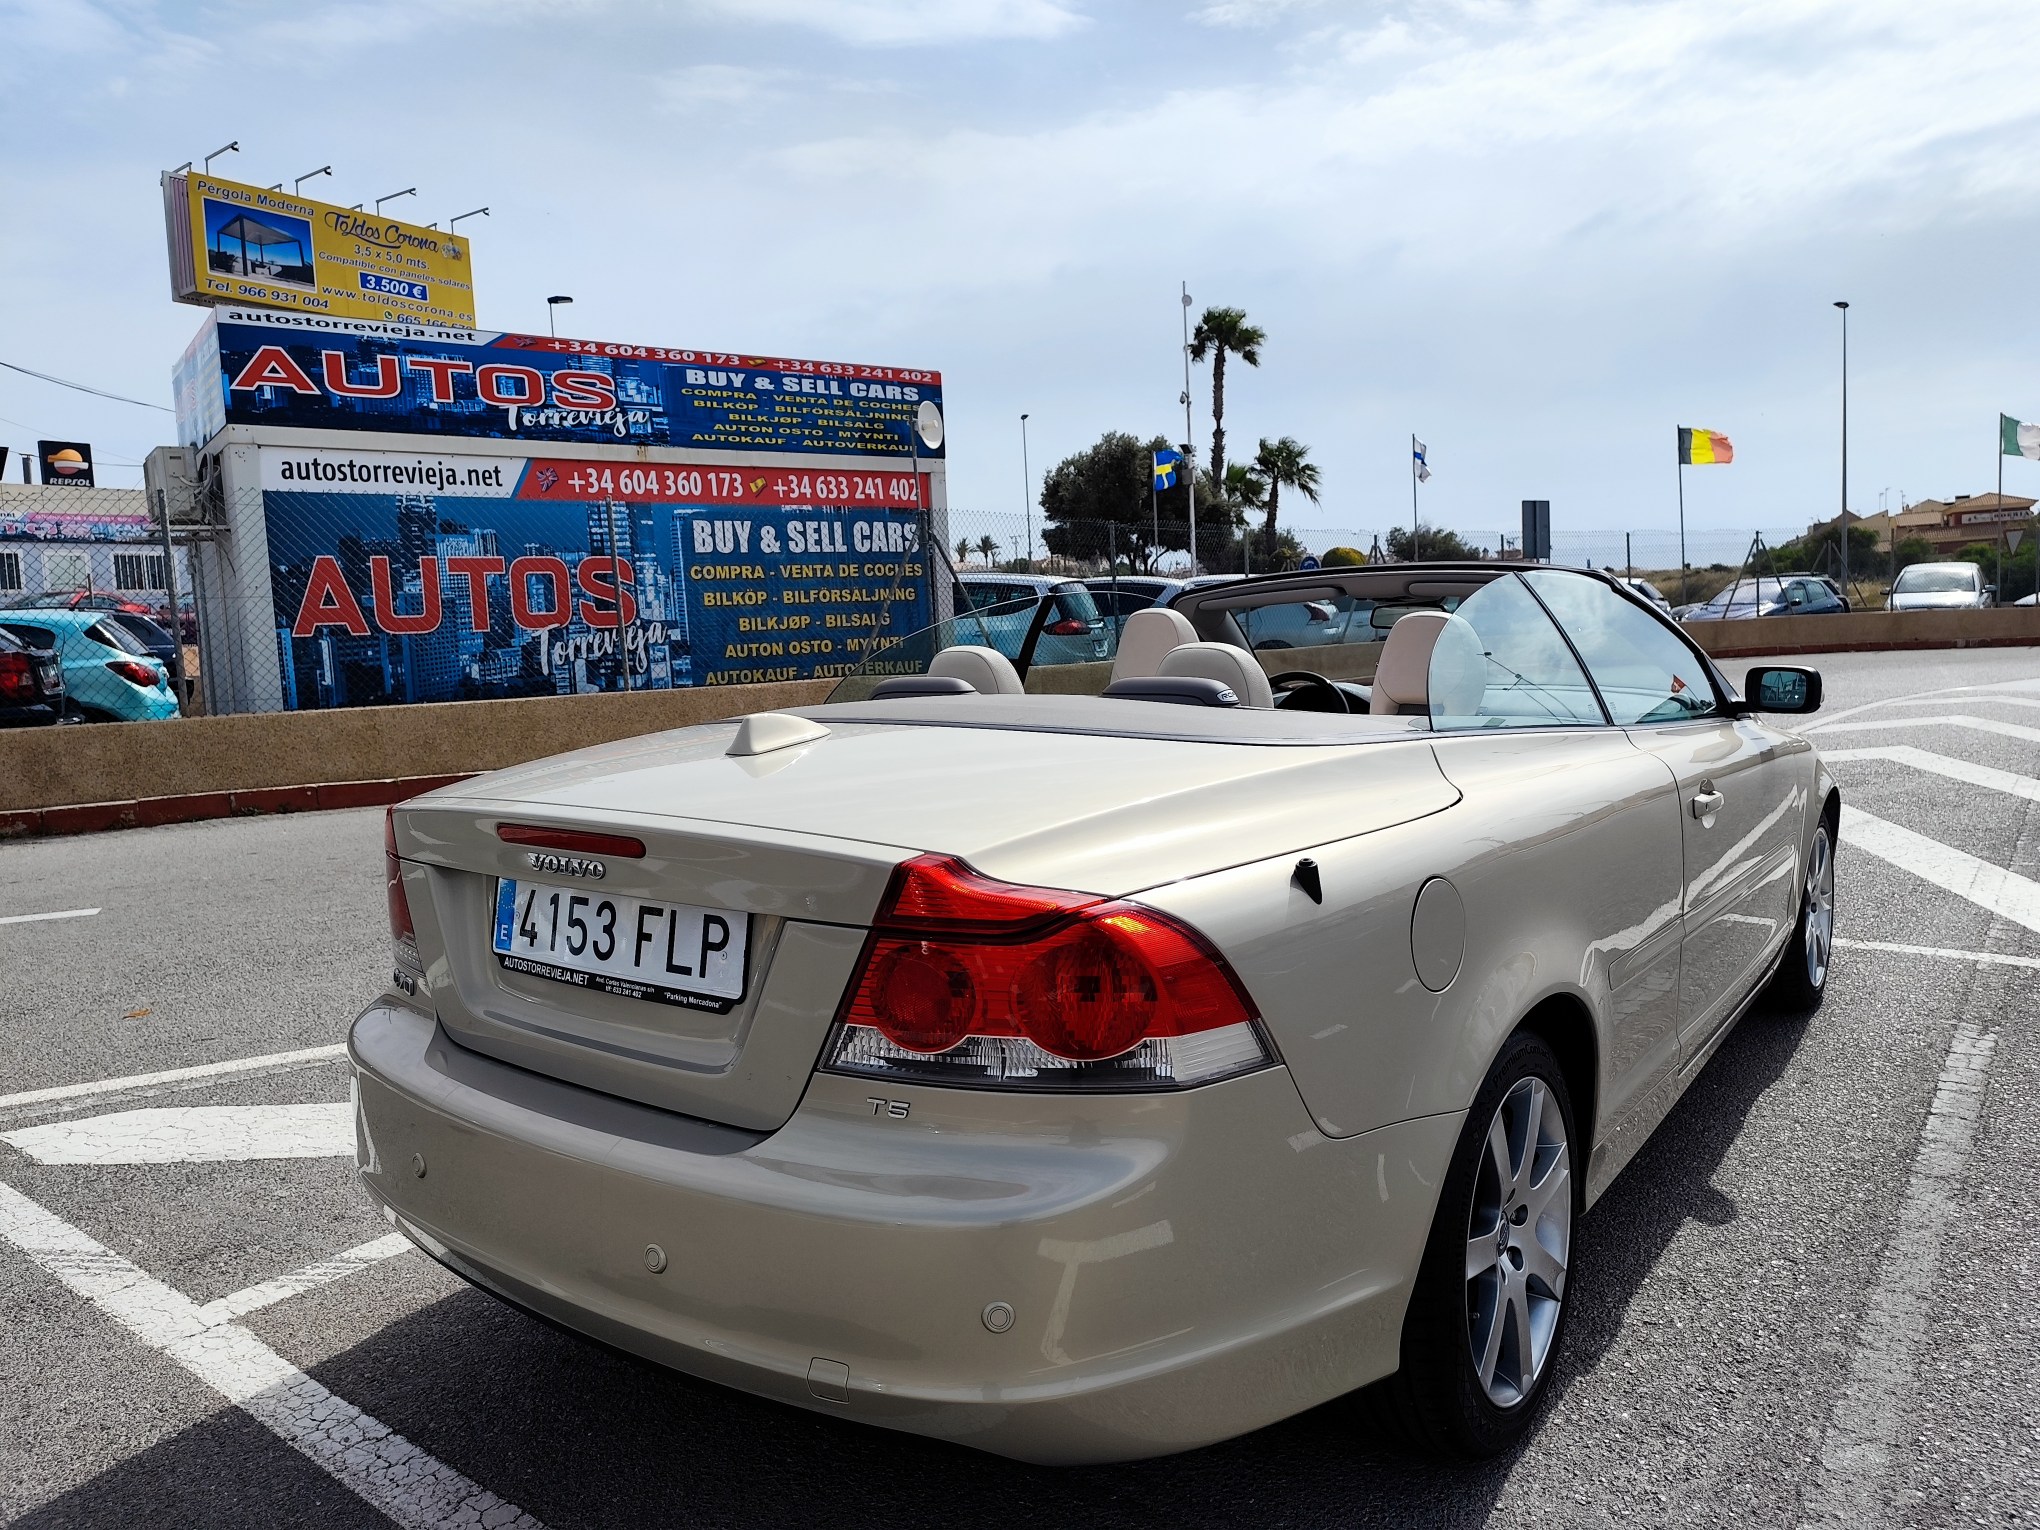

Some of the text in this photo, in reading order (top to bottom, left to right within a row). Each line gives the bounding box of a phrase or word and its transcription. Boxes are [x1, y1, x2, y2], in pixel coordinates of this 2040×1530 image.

[197, 180, 314, 216] Pérgola Moderna
[324, 212, 439, 253] Toldos Corona
[354, 244, 430, 270] 3,5 x 5,0 mts.
[318, 252, 471, 290] Compatible con paneles solares
[205, 278, 328, 309] Tel. 966 931 004
[366, 276, 423, 299] 3.500 €
[322, 286, 473, 322] www.toldoscorona.es
[228, 311, 476, 342] autostorrevieja.net
[397, 314, 420, 325] 665
[548, 340, 740, 366] +34 604 360 173
[230, 345, 617, 412] AUTOS
[773, 360, 933, 382] +34 633 241 402
[686, 369, 919, 401] BUY & SELL CARS
[681, 388, 757, 400] COMPRA
[773, 395, 827, 405] VENTA
[858, 400, 920, 412] COCHES
[693, 400, 759, 412] BILKÖP
[498, 402, 650, 438] Torrevieja
[713, 424, 774, 434] AUTON
[779, 428, 823, 436] OSTO
[838, 430, 899, 441] MYYNTI
[728, 414, 802, 424] BILKJØP
[817, 419, 885, 430] BILSALG
[691, 434, 787, 445] AUTOKAUF
[50, 478, 91, 488] REPSOL
[281, 458, 503, 490] autostorrevieja.net
[568, 468, 744, 498] +34 604 360 173
[773, 476, 919, 500] +34 633 241 402
[692, 520, 920, 554] BUY & SELL CARS
[690, 565, 764, 580] COMPRA
[780, 564, 834, 578] VENTA
[839, 564, 859, 577] DE
[292, 555, 637, 638] AUTOS
[704, 588, 768, 606] BILKÖP
[739, 614, 811, 632] BILKJØP
[825, 612, 891, 628] BILSALG
[531, 620, 668, 676] Torreveja
[725, 642, 784, 658] AUTON
[788, 639, 832, 654] OSTO
[706, 666, 798, 686] AUTOKAUF
[814, 660, 923, 679] AUTOVERKAUF
[527, 852, 606, 880] VOLVO
[500, 924, 508, 940] E
[520, 889, 731, 979] 4153 FLP
[504, 958, 590, 986] AUTOSTORREVIEJA.NET
[620, 981, 646, 992] Valencianas
[622, 988, 632, 996] 241
[866, 1096, 911, 1120] T5
